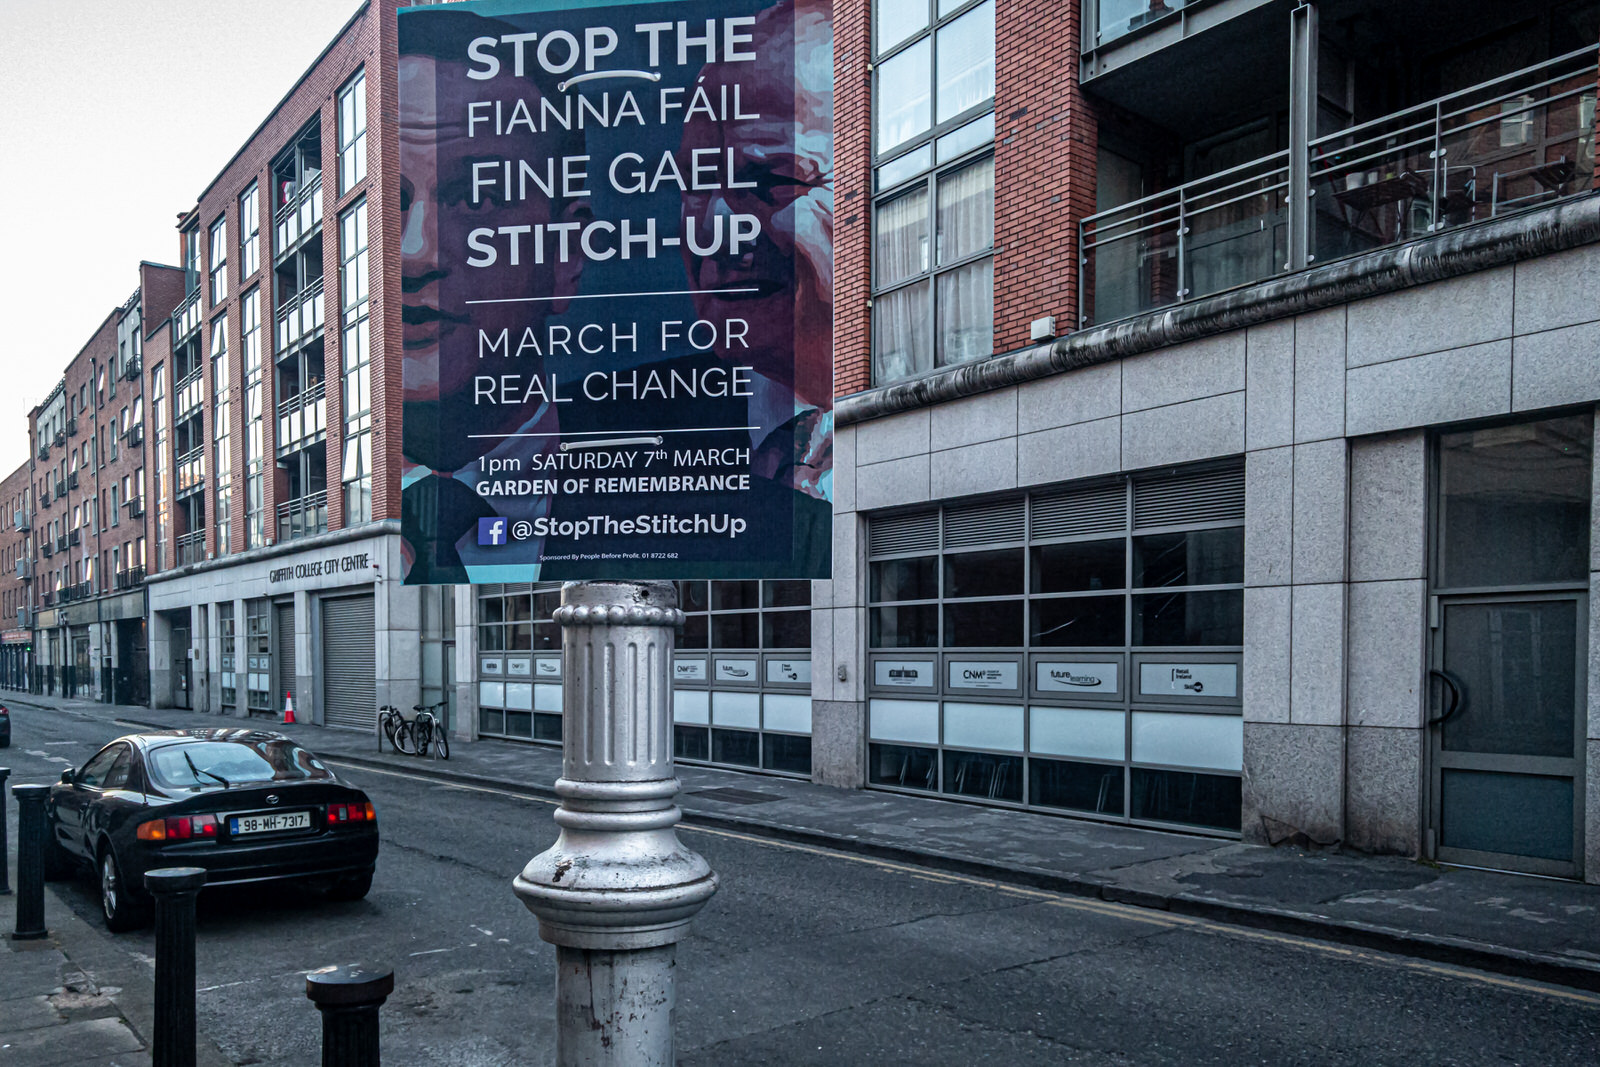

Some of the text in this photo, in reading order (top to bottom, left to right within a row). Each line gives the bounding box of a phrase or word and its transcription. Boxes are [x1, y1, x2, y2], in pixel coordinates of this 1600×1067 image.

[466, 16, 757, 80] STOP THE
[467, 76, 760, 138] FIANNA FÁIL
[472, 147, 758, 203] FINE GAEL
[466, 213, 761, 268] STITCH-UP
[478, 318, 750, 358] MARCH FOR
[474, 366, 754, 405] REAL CHANGE
[478, 447, 751, 475] 1pm SATURDAY 7th MARCH
[476, 474, 751, 497] GARDEN OF REMEMBRANCE
[511, 514, 748, 541] @StopTheStitchUp
[269, 553, 369, 583] GRIFFITH COLLEGE CITY CENTRE
[1050, 669, 1071, 678] future
[244, 815, 304, 831] 98-MH-7317
